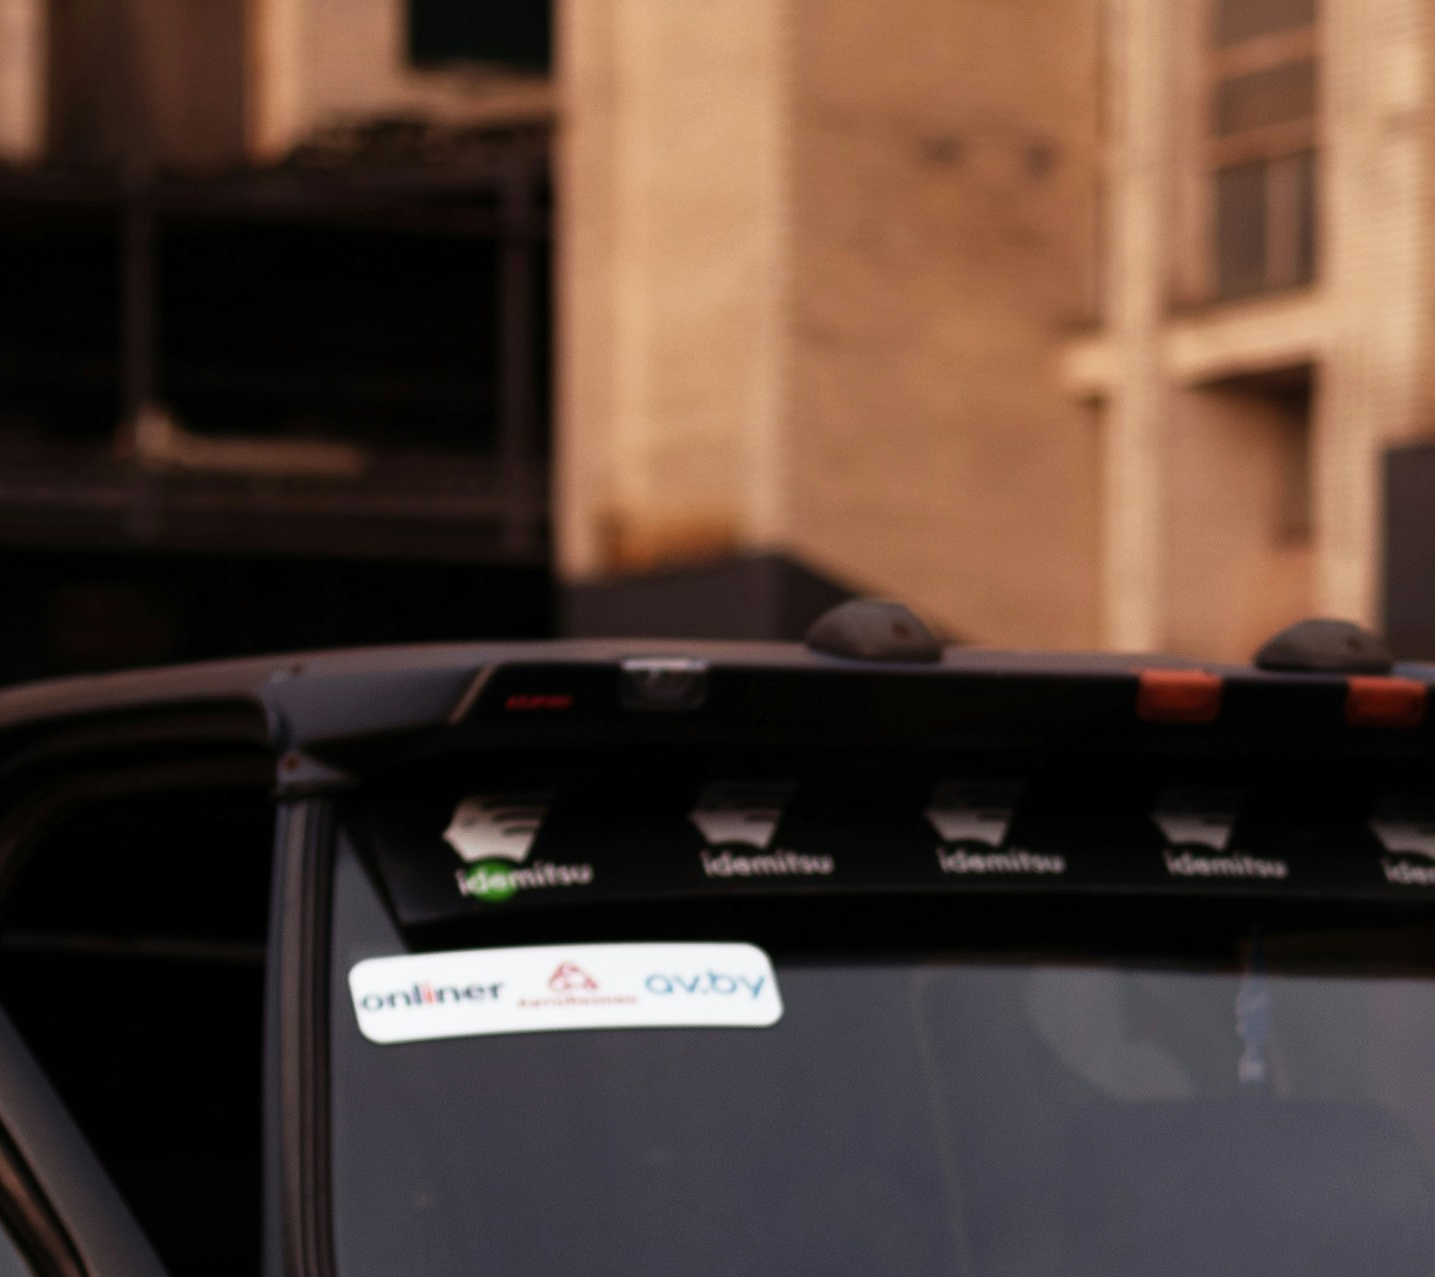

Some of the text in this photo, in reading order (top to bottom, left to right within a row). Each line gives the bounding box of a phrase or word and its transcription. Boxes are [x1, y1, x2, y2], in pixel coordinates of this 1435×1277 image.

[702, 850, 834, 877] idemitsu
[938, 848, 1065, 875] idemitsu
[1165, 852, 1288, 880] idemitsu
[458, 860, 593, 897] idemitsu
[362, 980, 504, 1011] onliner
[644, 969, 765, 999] av.by
